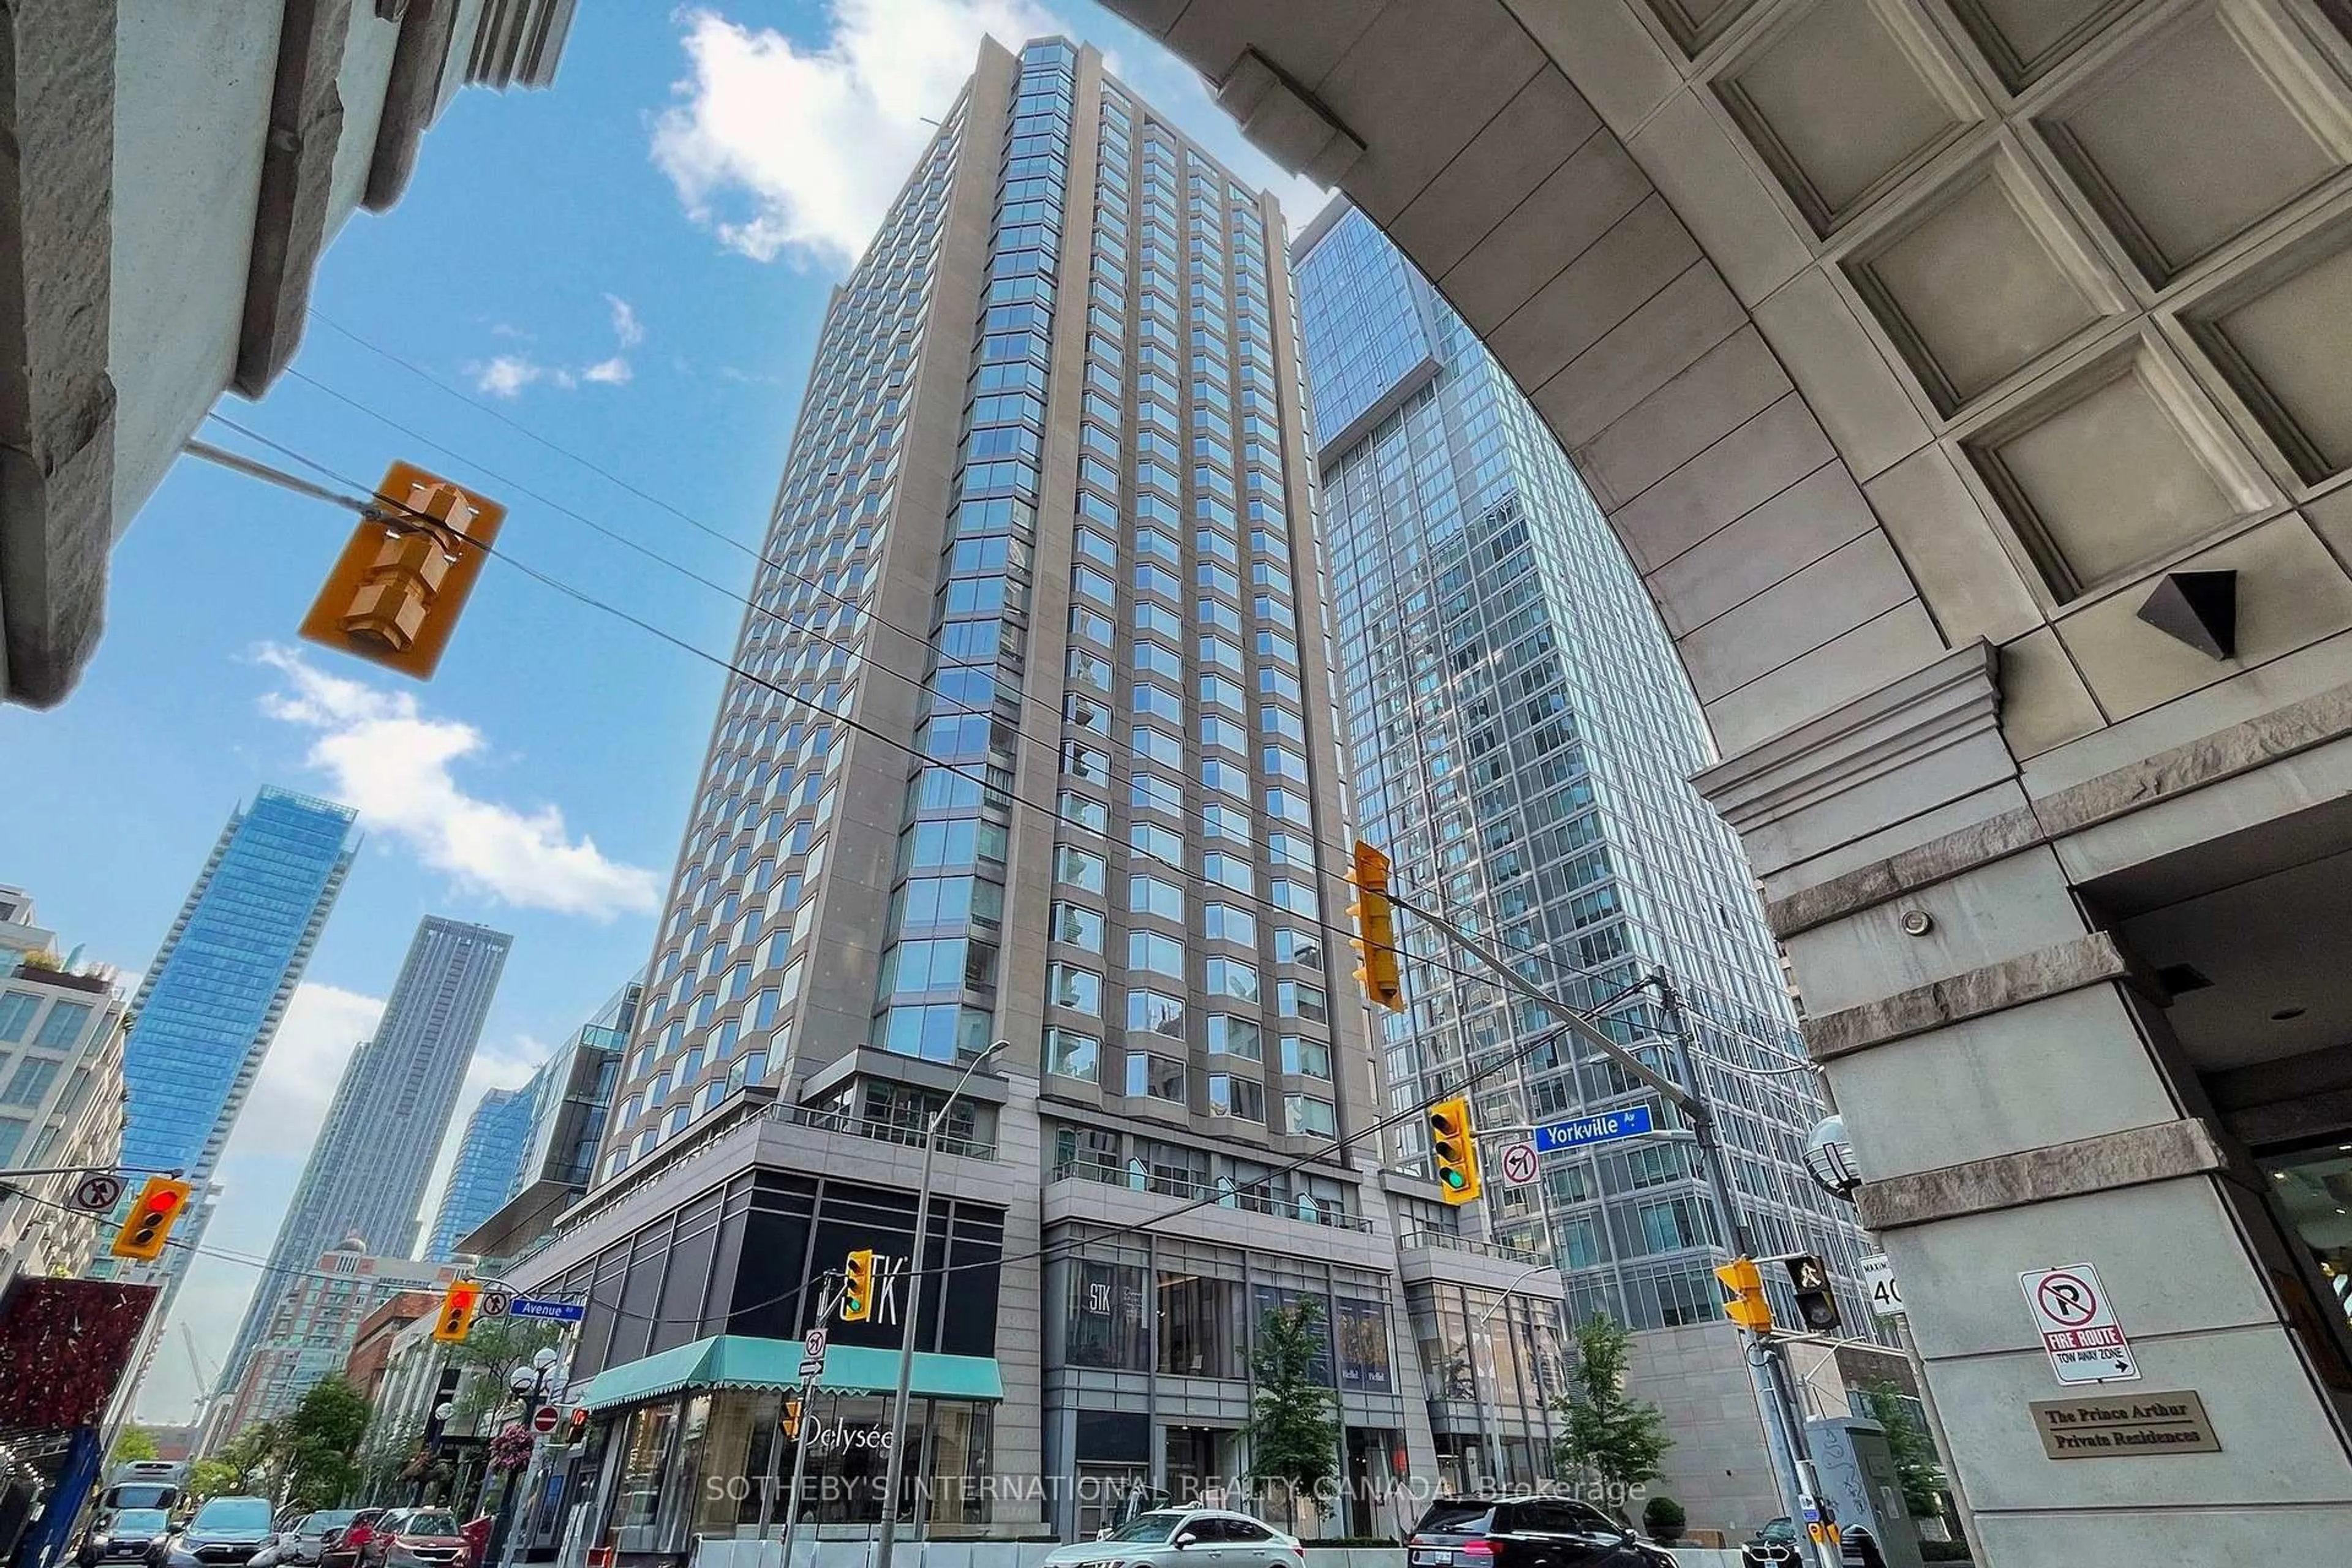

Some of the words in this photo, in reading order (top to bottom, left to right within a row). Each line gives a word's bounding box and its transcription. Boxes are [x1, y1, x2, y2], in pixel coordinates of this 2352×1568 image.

[1547, 1117, 1618, 1144] Yorkville
[1090, 1283, 1110, 1311] STK
[522, 1302, 562, 1316] Avenue
[2048, 1332, 2076, 1349] FIRE
[2077, 1327, 2119, 1346] ROUTE
[2057, 1352, 2076, 1363] TOW
[2077, 1350, 2098, 1361] AWAY
[2098, 1348, 2124, 1359] ZONE
[2045, 1409, 2076, 1424] The
[2078, 1408, 2129, 1422] Prince
[2132, 1401, 2187, 1419] Arthur
[2053, 1434, 2111, 1449] Private
[2111, 1430, 2201, 1446] Residences
